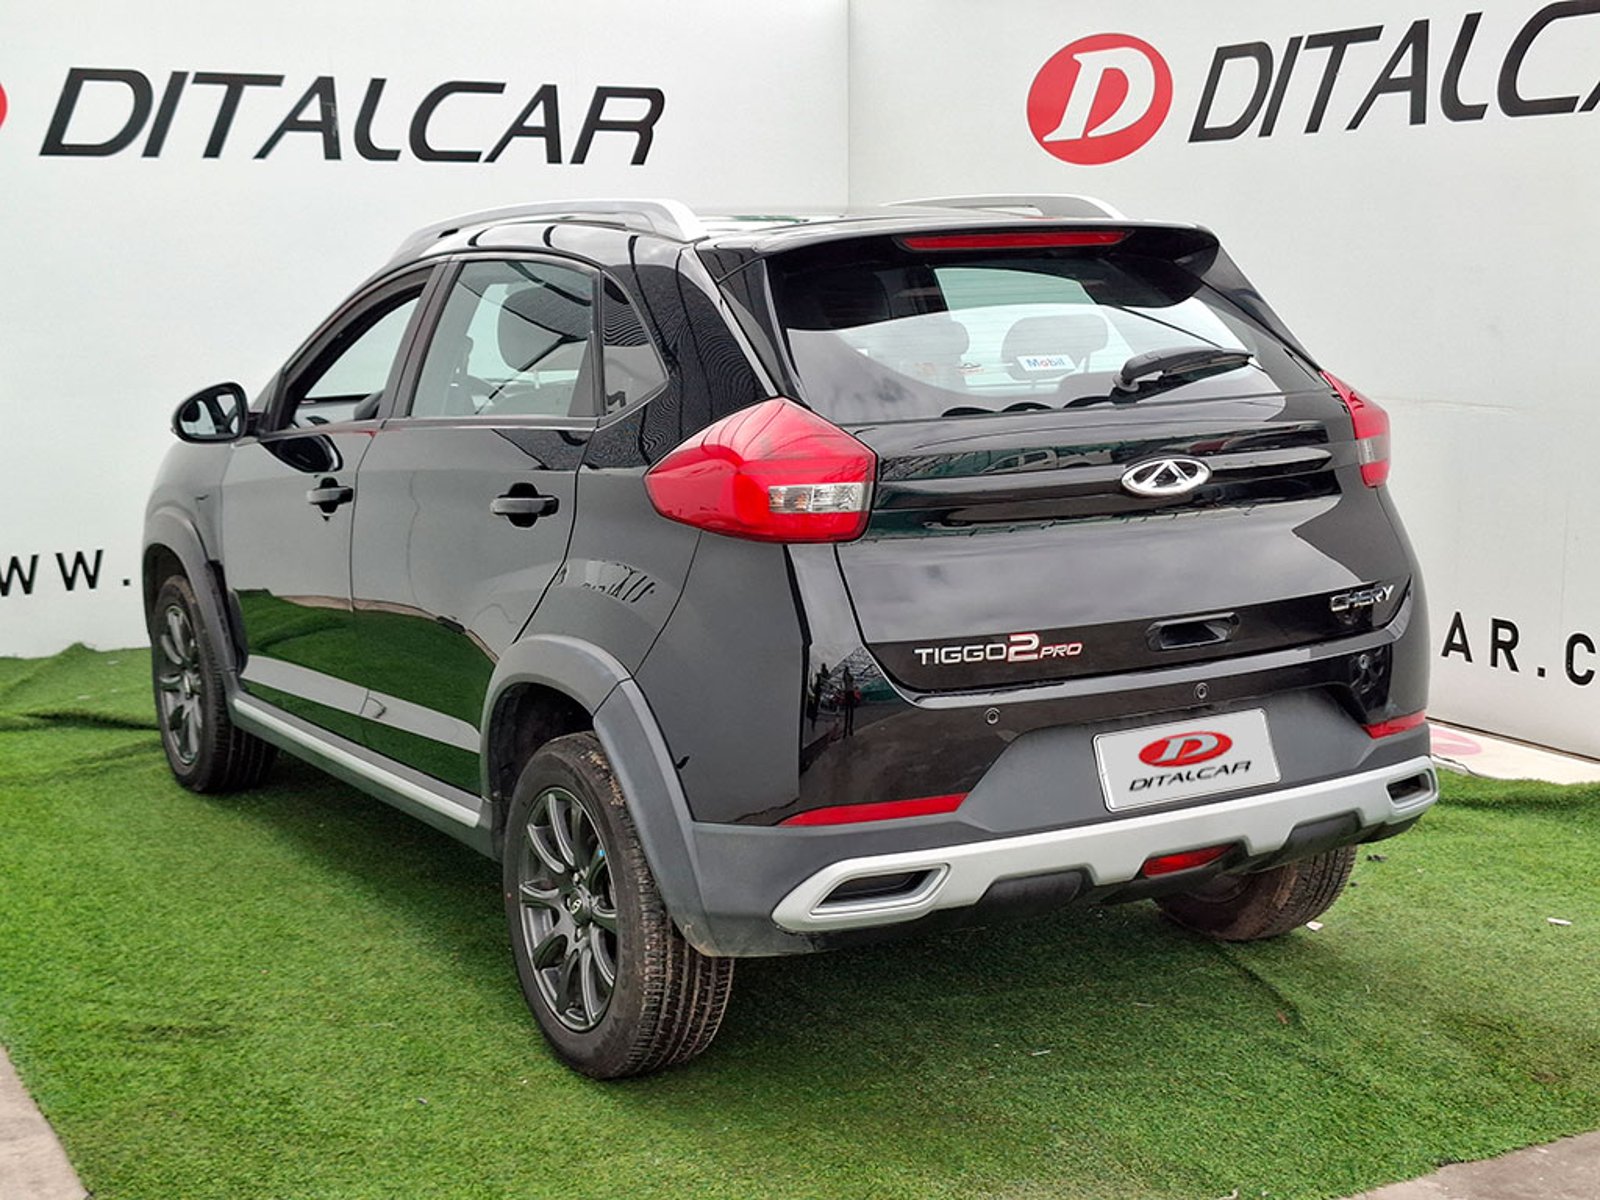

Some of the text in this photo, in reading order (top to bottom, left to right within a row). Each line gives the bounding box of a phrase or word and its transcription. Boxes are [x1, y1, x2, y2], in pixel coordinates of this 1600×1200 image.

[39, 67, 665, 165] DITALCAR
[1188, 0, 1600, 143] DITALC
[1128, 760, 1251, 792] DITALCAR
